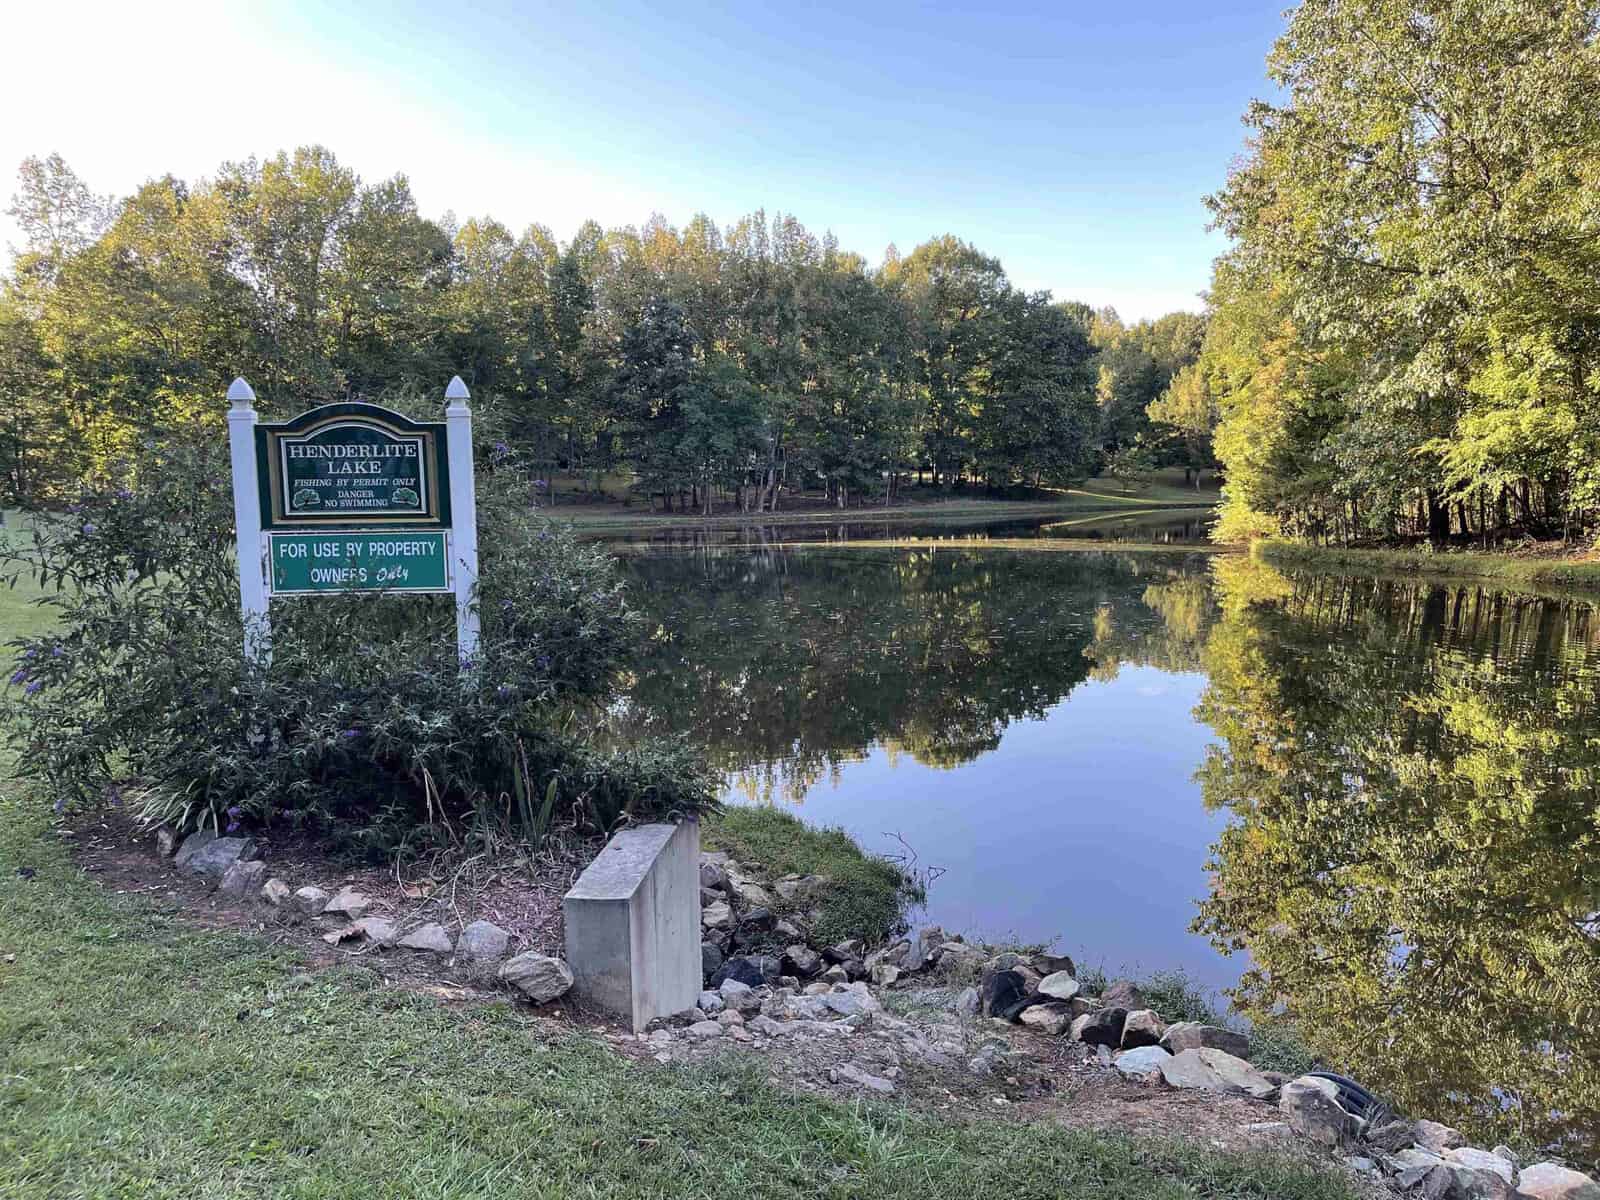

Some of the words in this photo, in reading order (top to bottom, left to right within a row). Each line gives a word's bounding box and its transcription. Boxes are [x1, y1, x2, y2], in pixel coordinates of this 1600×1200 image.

[289, 444, 417, 458] HENDERLITE
[328, 461, 381, 474] LAKE
[294, 479, 332, 487] FISHING
[336, 479, 348, 487] BY
[392, 478, 416, 486] ONLY
[338, 490, 374, 498] DANGER
[340, 499, 388, 507] SWIMMING
[280, 543, 307, 558] FOR
[313, 542, 341, 558] USE
[346, 542, 363, 557] BY
[369, 541, 436, 556] PROPERTY
[376, 565, 408, 582] Only
